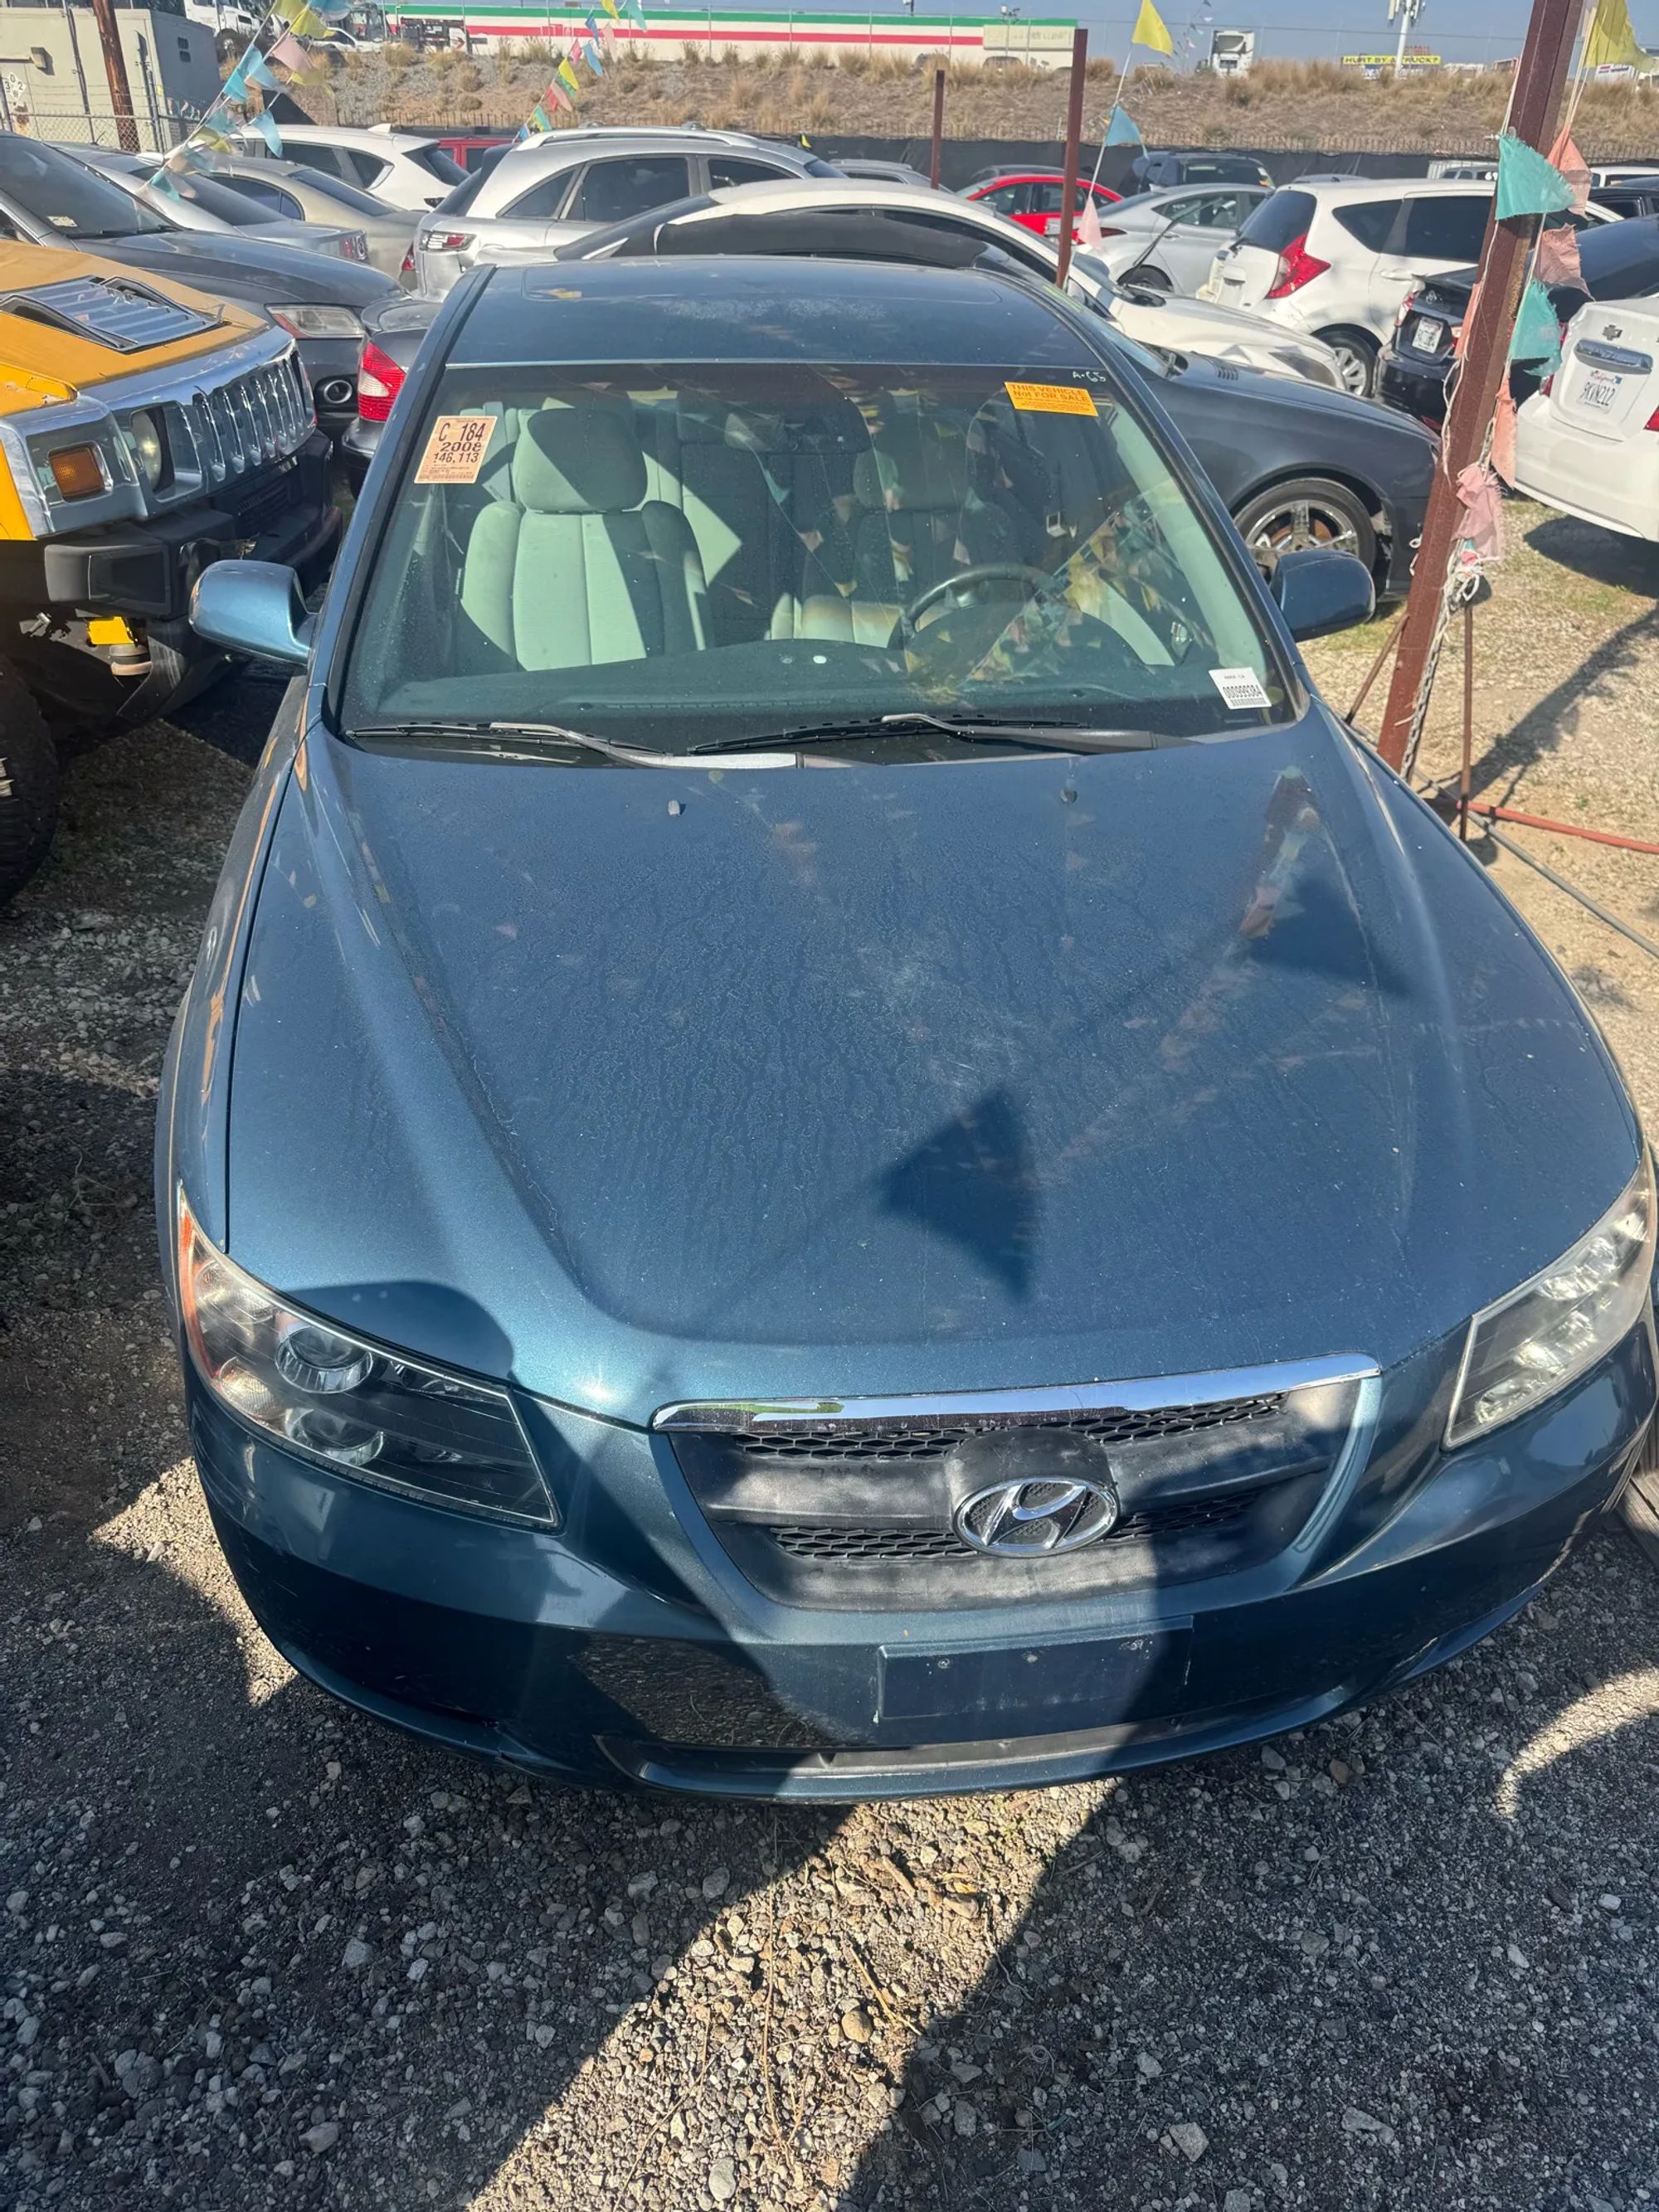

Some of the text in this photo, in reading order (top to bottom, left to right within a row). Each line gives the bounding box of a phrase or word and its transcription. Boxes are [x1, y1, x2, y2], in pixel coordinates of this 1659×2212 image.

[1012, 384, 1086, 395] THIS VEHICLE
[1061, 393, 1088, 401] SALE
[438, 422, 486, 442] C 184
[433, 452, 479, 464] 146,113
